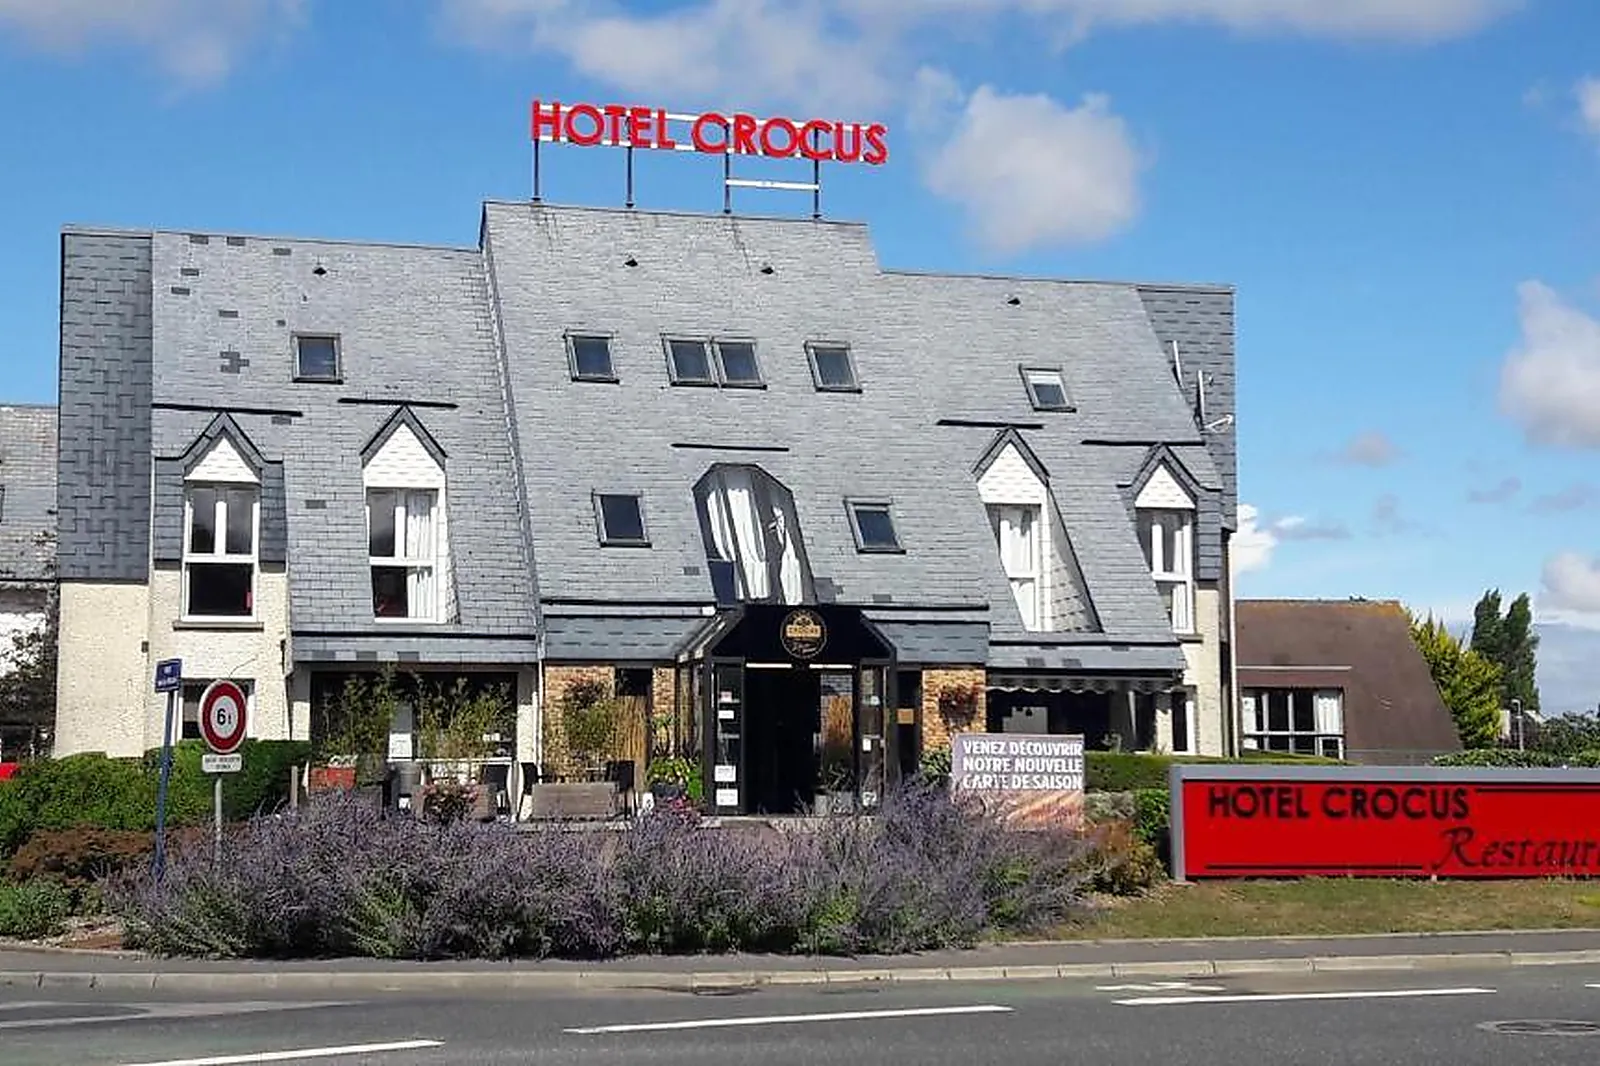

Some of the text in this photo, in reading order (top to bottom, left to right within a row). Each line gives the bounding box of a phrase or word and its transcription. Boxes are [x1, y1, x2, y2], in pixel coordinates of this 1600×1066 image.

[531, 99, 888, 165] HOTEL CROCUS
[962, 740, 1007, 756] VENEZ
[962, 758, 1083, 773] NOTRE NOUVELLE
[962, 774, 1083, 790] CARTE DE SAISON
[1208, 785, 1470, 820] HOTEL CROCUS
[1431, 825, 1600, 870] Restaur
